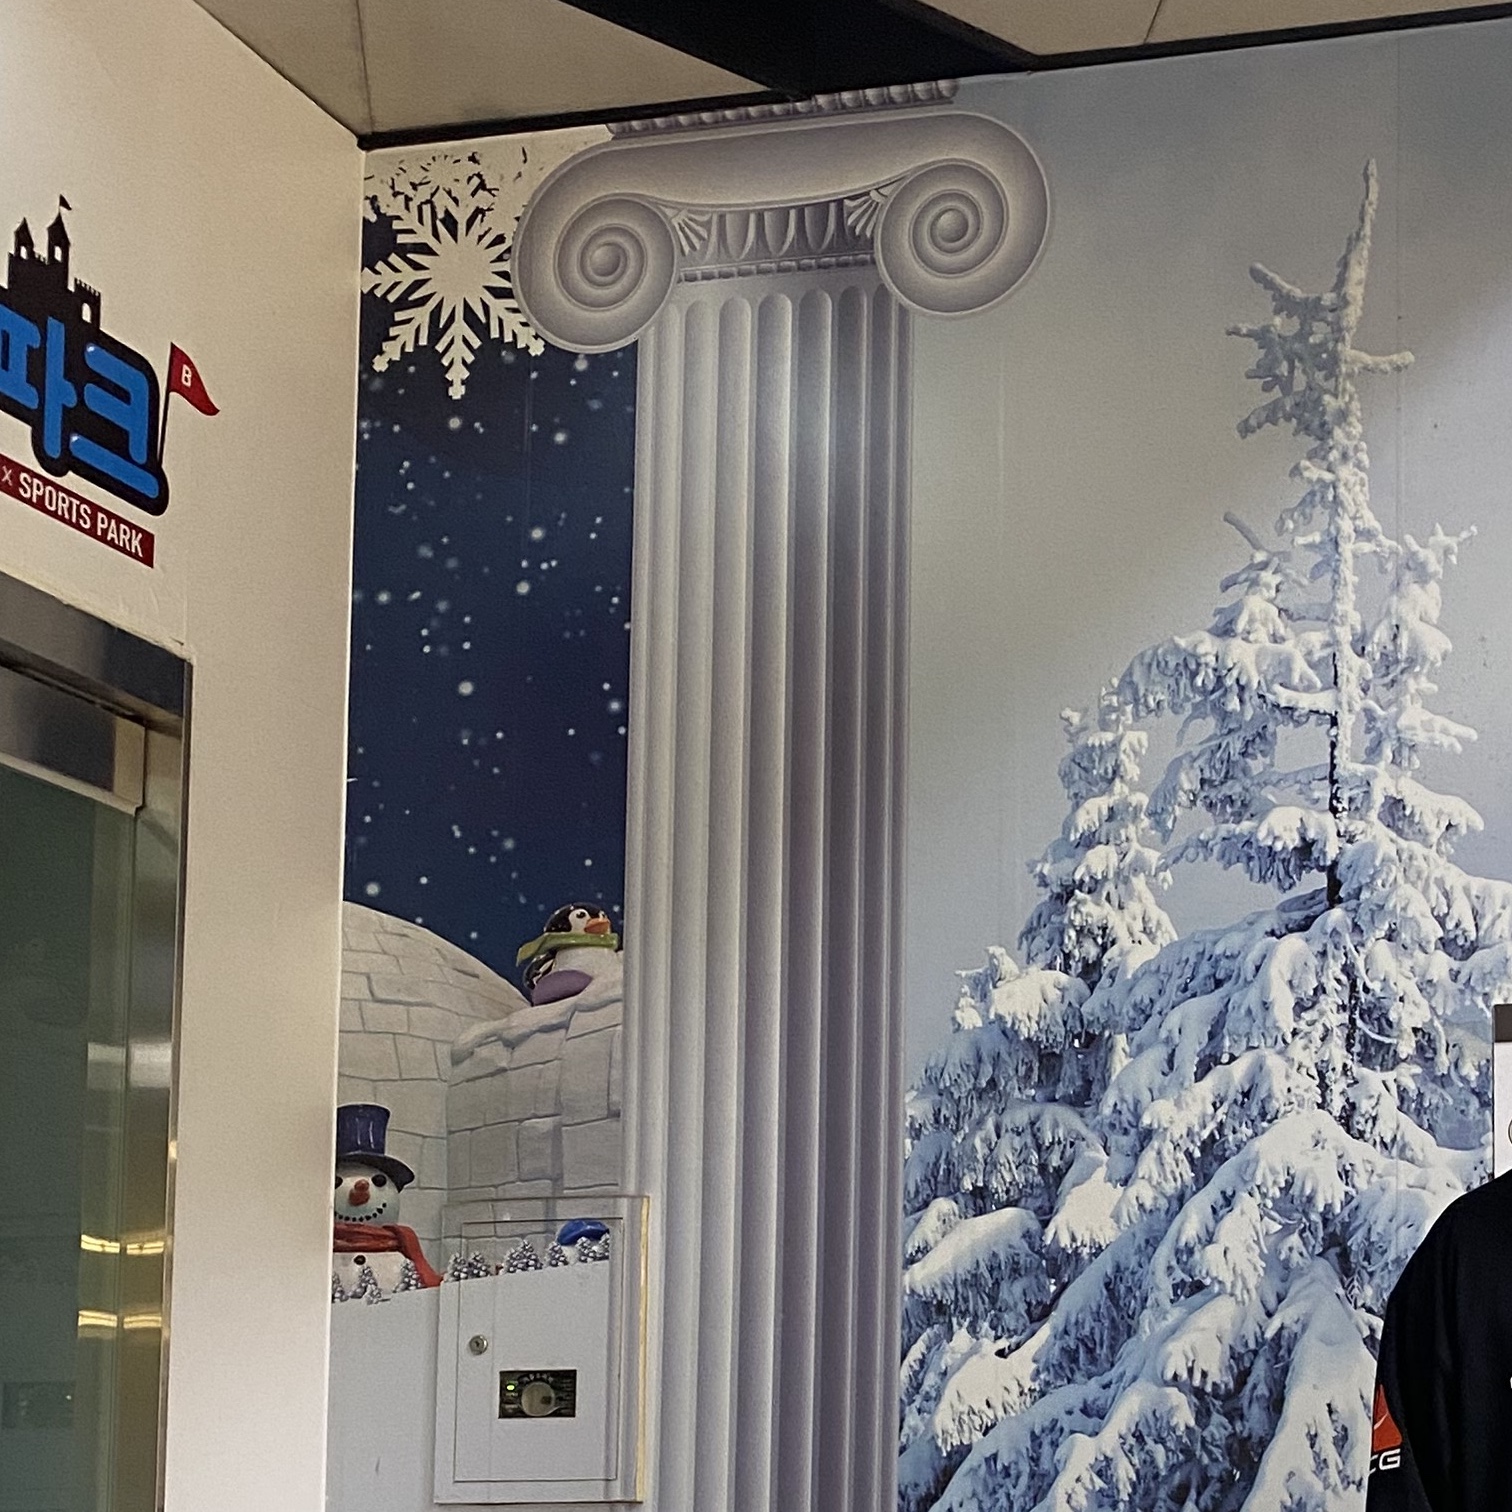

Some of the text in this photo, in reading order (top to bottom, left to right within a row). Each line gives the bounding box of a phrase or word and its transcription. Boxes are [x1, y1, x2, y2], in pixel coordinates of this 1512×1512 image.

[181, 363, 193, 388] B
[19, 471, 92, 530] SPORTS
[97, 511, 144, 558] PARK
